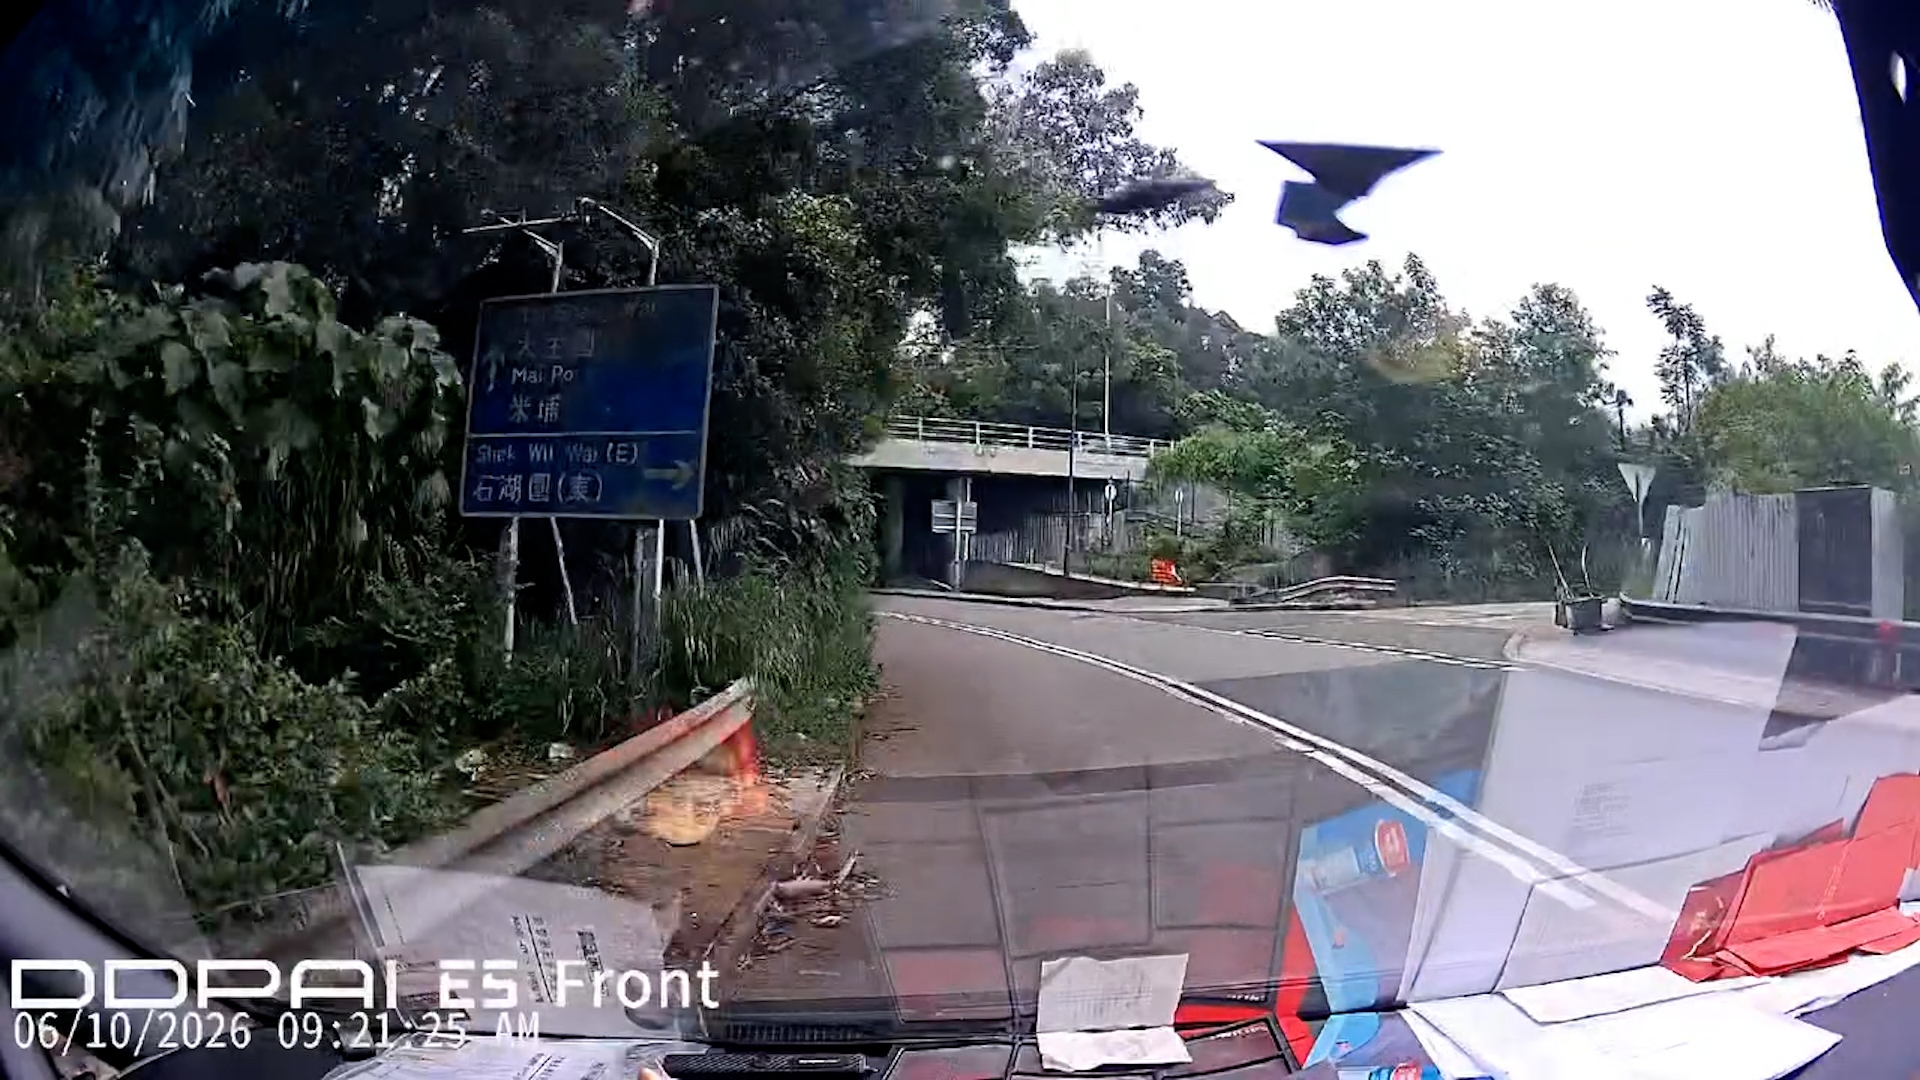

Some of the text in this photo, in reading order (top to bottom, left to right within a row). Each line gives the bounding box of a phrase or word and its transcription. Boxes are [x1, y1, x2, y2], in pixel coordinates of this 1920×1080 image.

[510, 364, 575, 385] Mai Po
[606, 441, 639, 465] (E)
